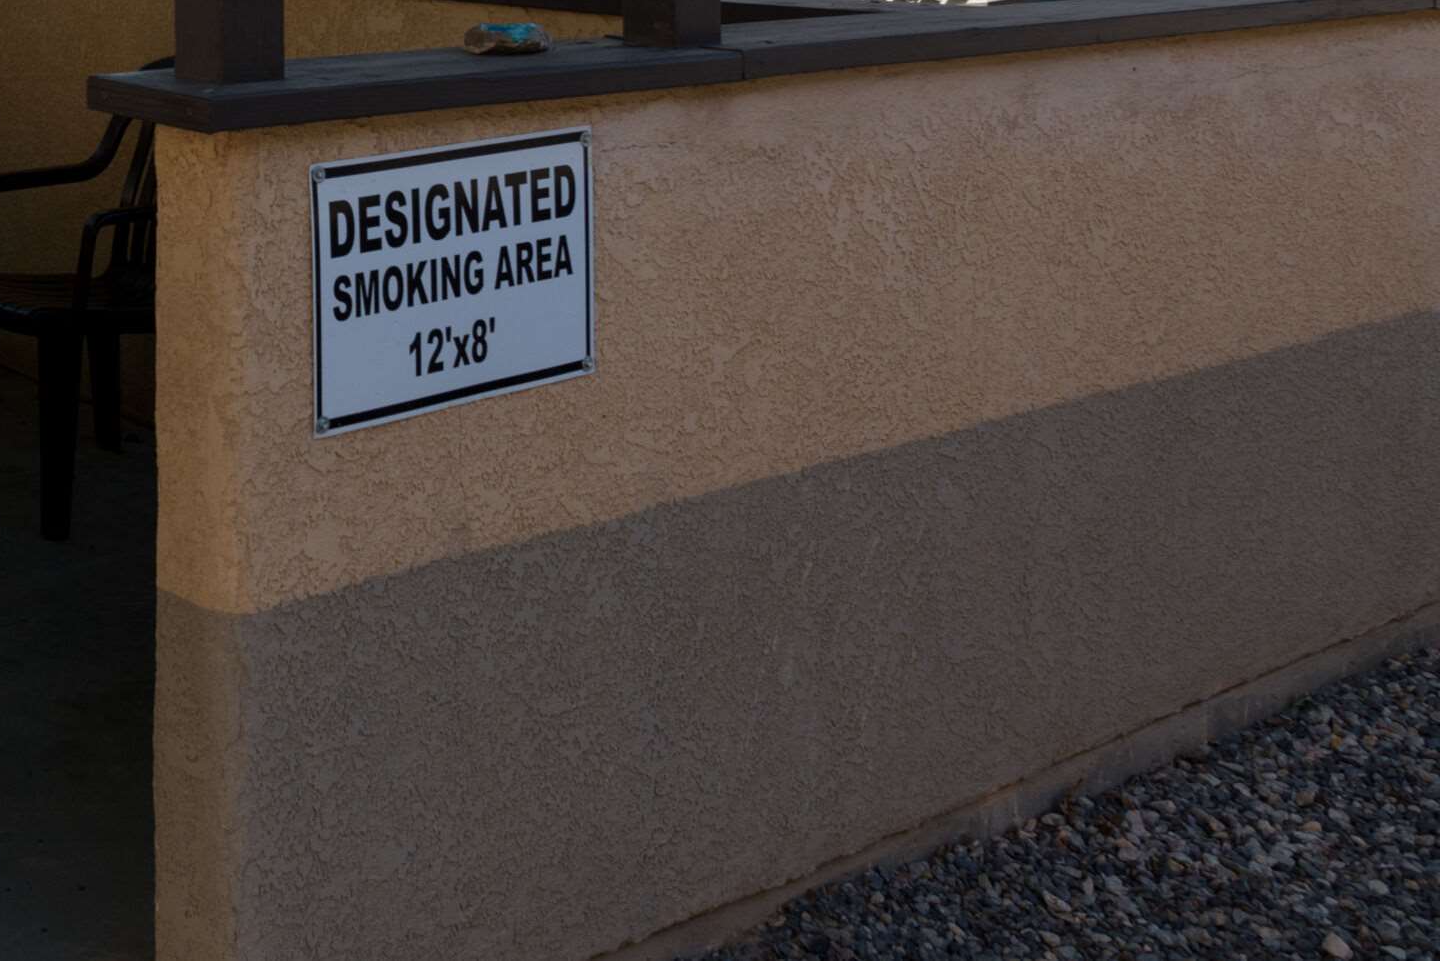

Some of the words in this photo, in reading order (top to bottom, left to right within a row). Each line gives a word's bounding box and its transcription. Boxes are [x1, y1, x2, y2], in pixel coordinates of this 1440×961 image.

[329, 164, 576, 259] DESIGNATED
[332, 250, 484, 322] SMOKING
[494, 234, 574, 290] AREA
[409, 317, 496, 377] 12'x8'
